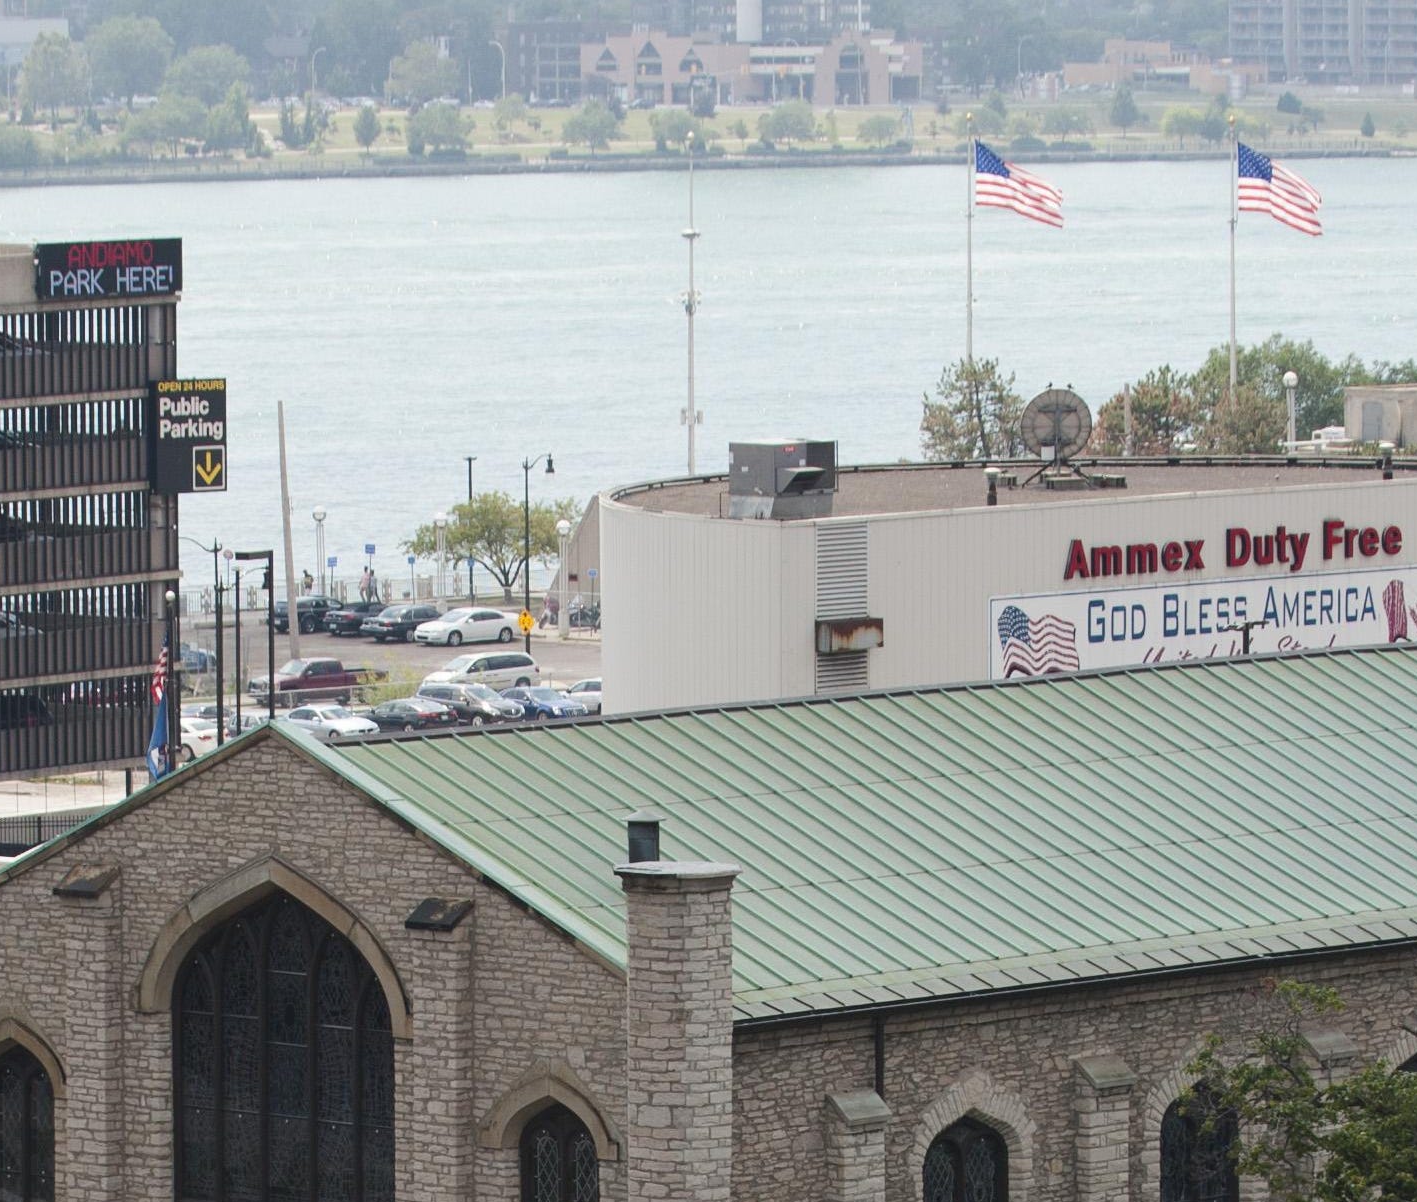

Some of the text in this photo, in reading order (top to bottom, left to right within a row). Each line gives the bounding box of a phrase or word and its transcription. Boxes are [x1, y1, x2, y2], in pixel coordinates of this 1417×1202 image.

[68, 242, 153, 268] ANDIAMO
[50, 265, 173, 296] PARK HERE!
[158, 380, 225, 392] OPEN 24 HOURS
[159, 396, 209, 416] Public
[159, 418, 223, 441] Parking
[1064, 519, 1402, 580] Ammex Duty Free
